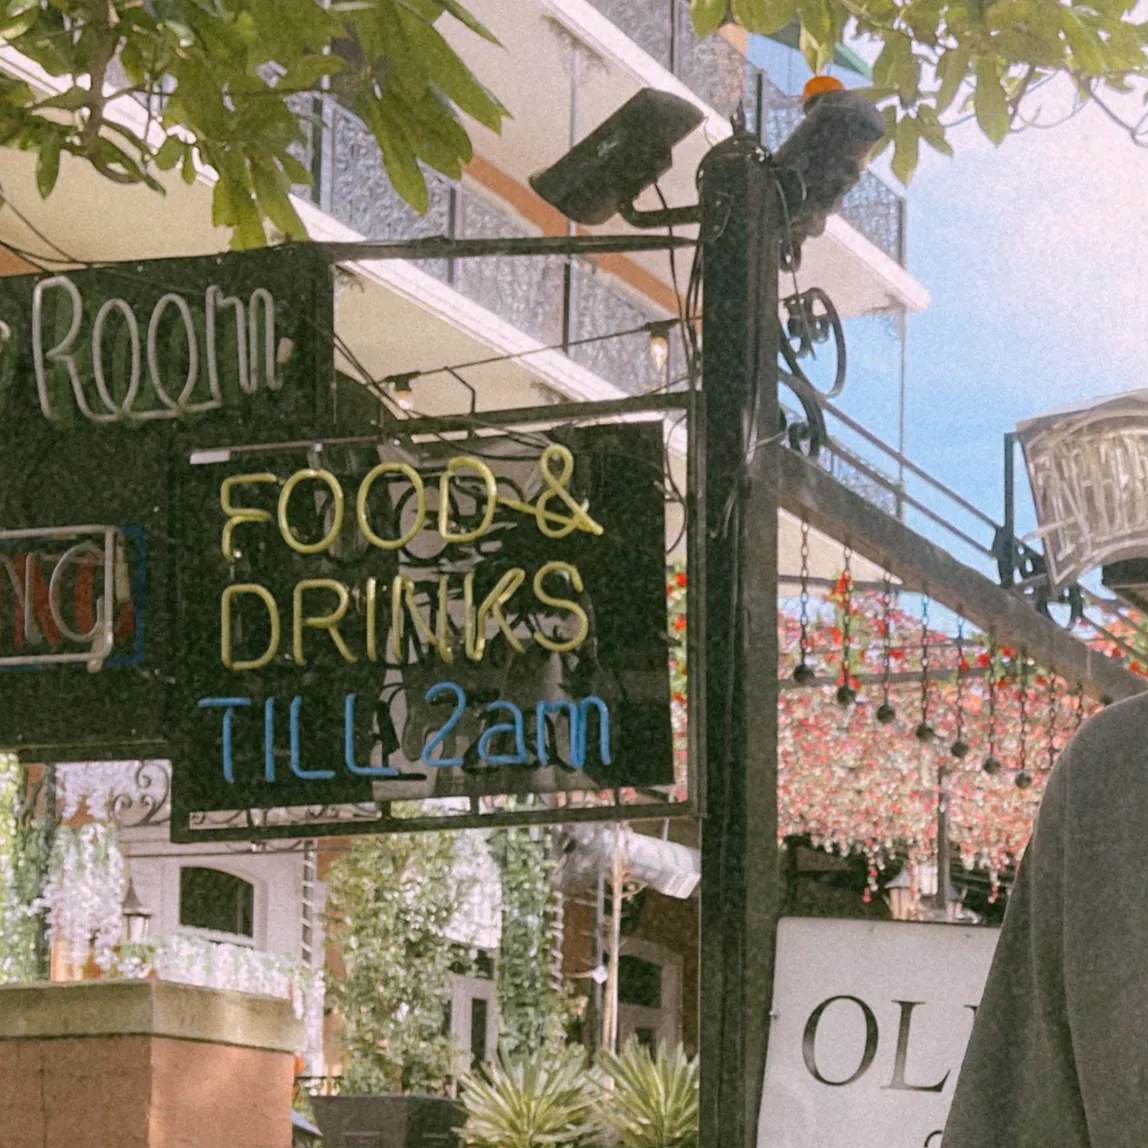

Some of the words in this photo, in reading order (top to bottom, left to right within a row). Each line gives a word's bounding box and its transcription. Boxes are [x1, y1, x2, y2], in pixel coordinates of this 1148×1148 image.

[221, 456, 497, 560] FOOD
[536, 443, 604, 538] &
[221, 561, 589, 670] DRINKS
[198, 693, 400, 784] TILL
[421, 682, 612, 769] 2am
[801, 994, 978, 1093] OL
